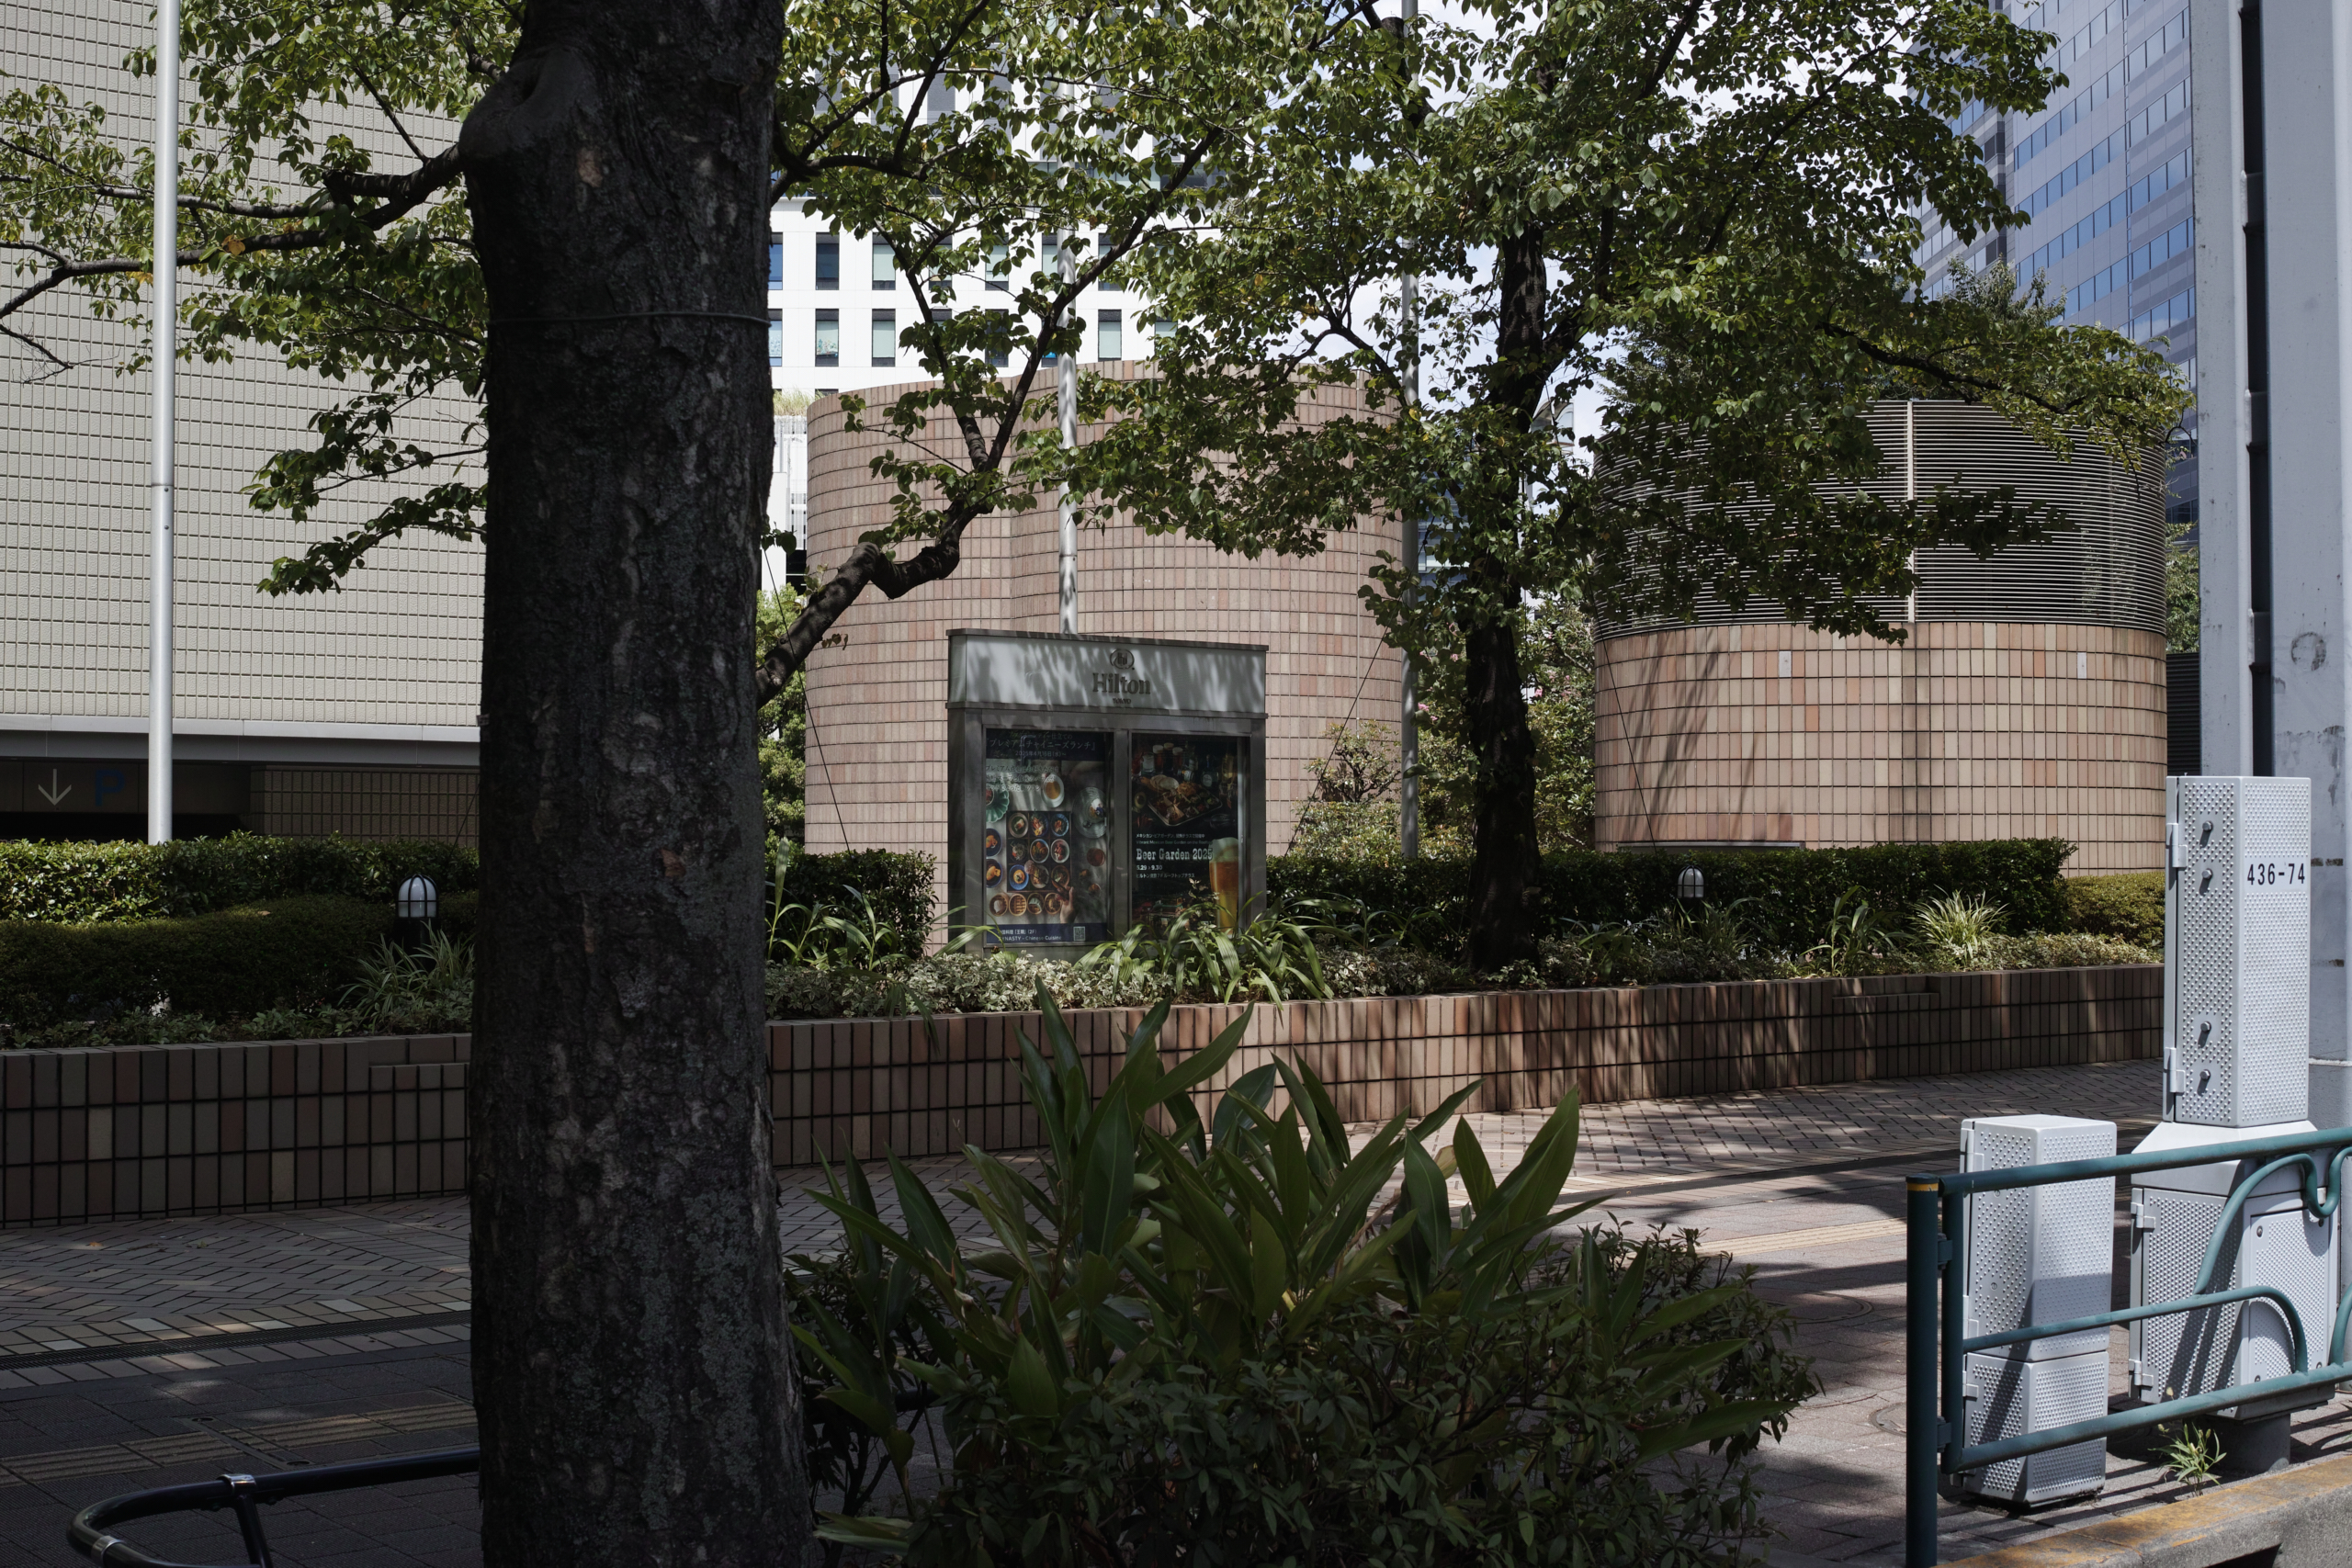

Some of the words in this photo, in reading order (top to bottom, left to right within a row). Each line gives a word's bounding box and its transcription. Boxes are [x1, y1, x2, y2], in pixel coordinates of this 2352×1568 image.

[1092, 672, 1151, 694] Hilton
[96, 769, 126, 807] P
[1136, 848, 1157, 861] Beer
[1159, 848, 1190, 861] Garden
[1193, 848, 1214, 861] 2025
[2246, 863, 2306, 886] 436-74
